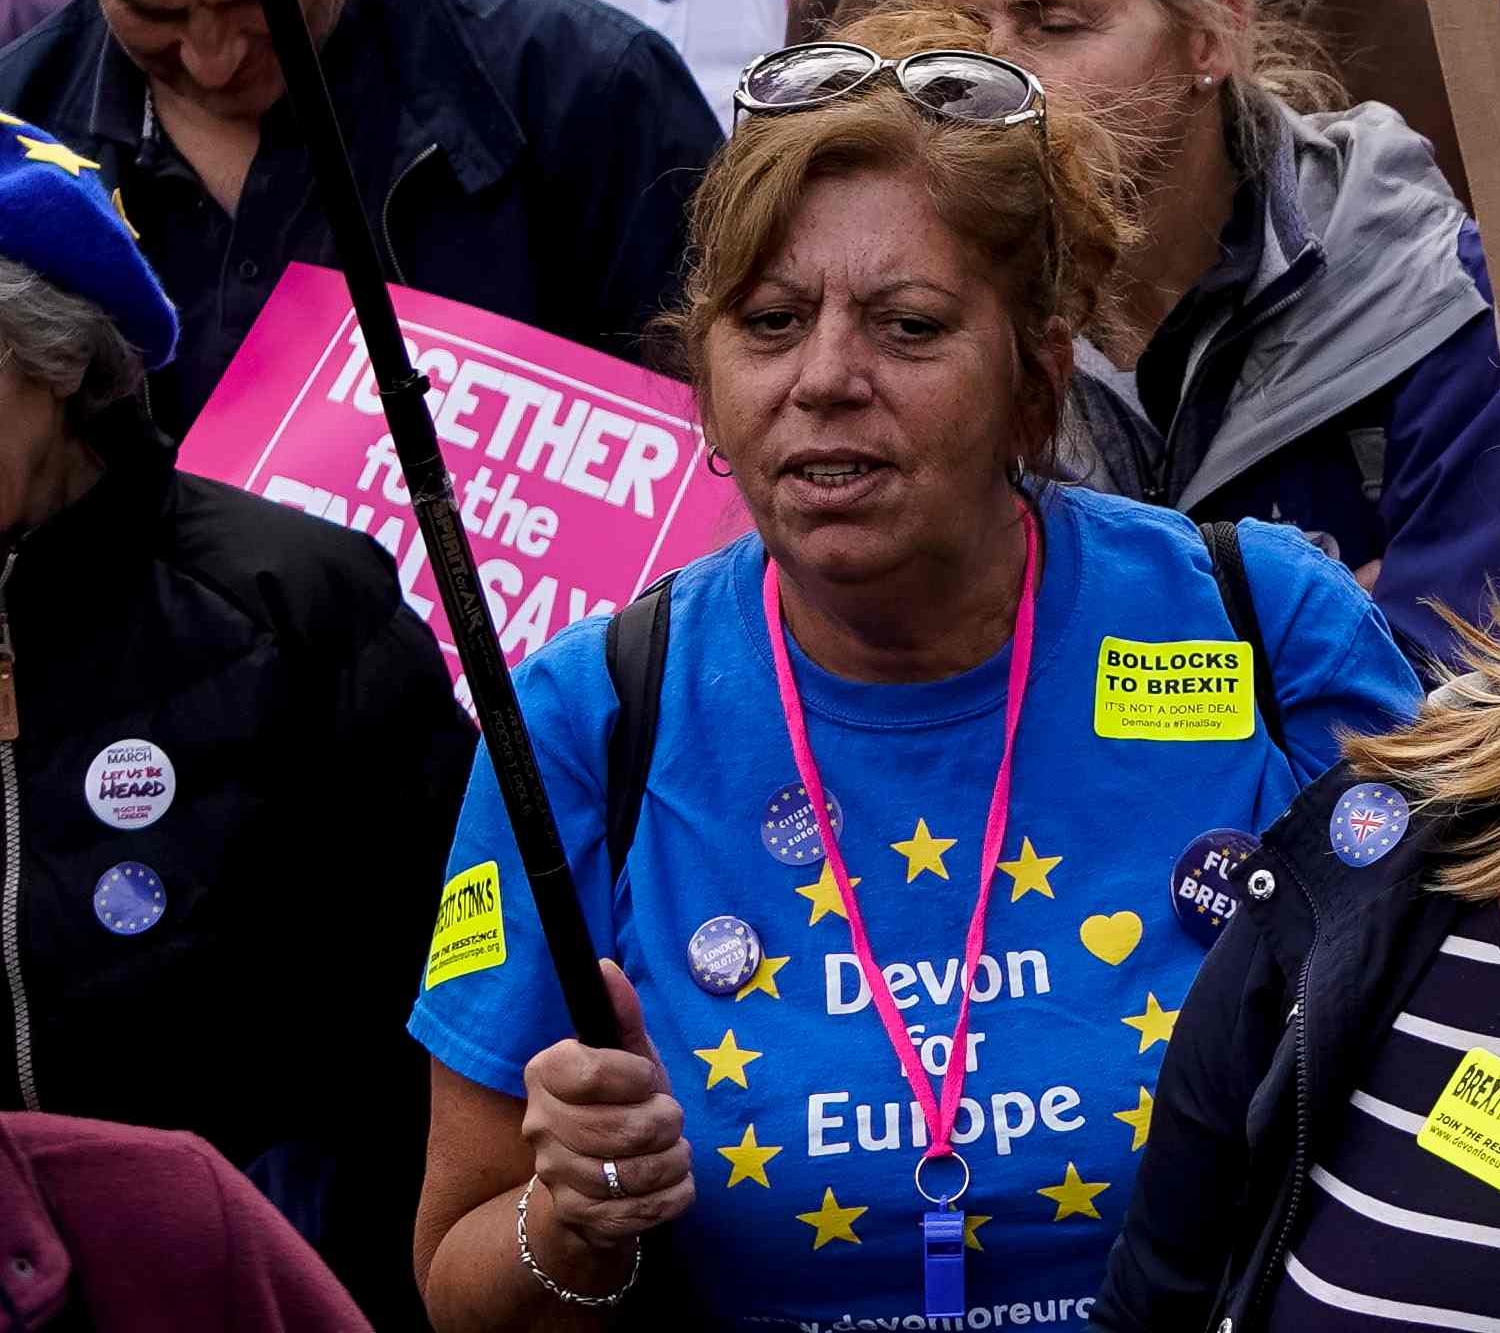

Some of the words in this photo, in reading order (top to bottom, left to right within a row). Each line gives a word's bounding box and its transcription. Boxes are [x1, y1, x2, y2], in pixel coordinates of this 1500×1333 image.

[463, 465, 560, 558] the
[1107, 649, 1240, 671] BOLLOCKS
[1105, 675, 1137, 693] TO
[1147, 676, 1240, 695] BREXIT
[1105, 701, 1126, 713] IT'S
[1129, 704, 1154, 714] NOT
[1157, 705, 1167, 715] A
[1169, 704, 1205, 715] DONE
[1208, 703, 1240, 715] DEAL
[107, 751, 153, 764] MARCH
[99, 779, 166, 801] HEARD
[795, 818, 809, 830] OF
[703, 936, 742, 963] LONDON
[824, 947, 1051, 1017] Devon
[900, 1023, 983, 1077] for
[1436, 1112, 1462, 1132] JOIN
[1464, 1125, 1484, 1143] THE
